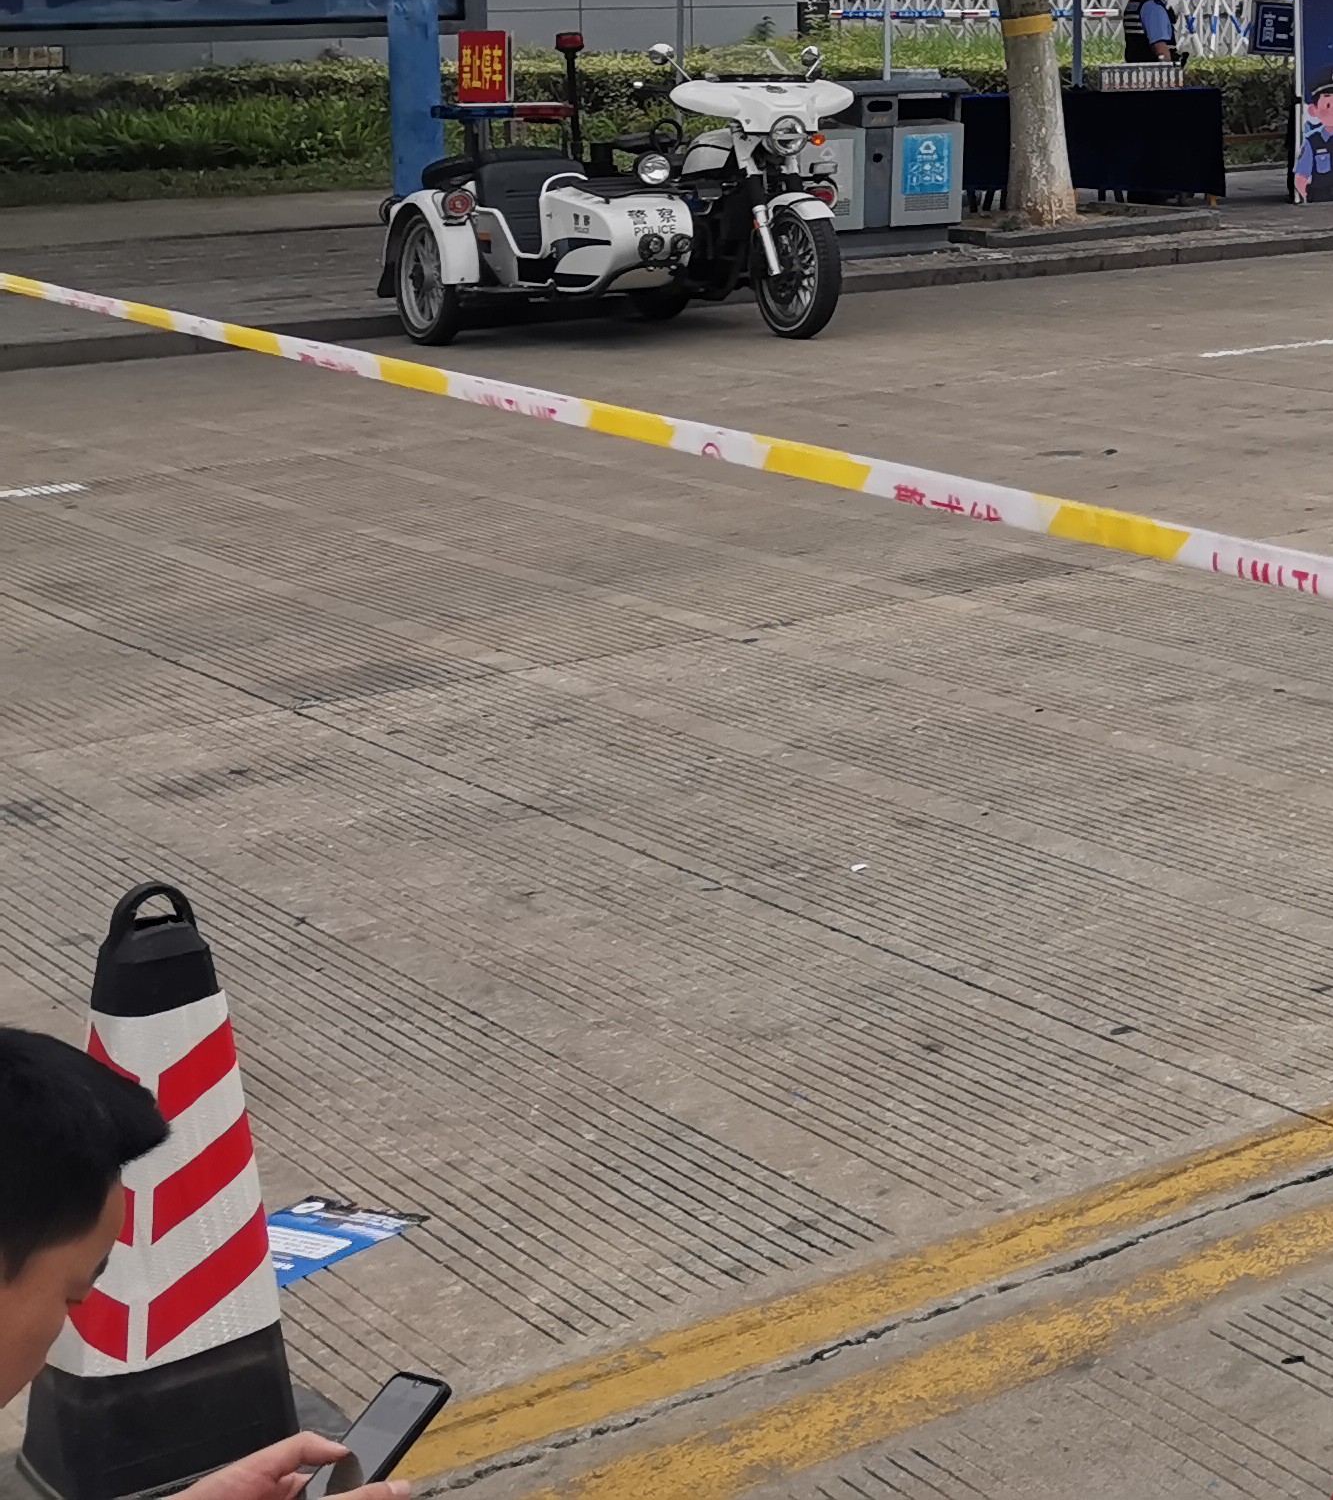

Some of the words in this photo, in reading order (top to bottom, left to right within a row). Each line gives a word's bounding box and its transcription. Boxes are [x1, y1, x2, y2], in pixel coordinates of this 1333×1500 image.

[1262, 11, 1295, 43] 高二
[461, 44, 502, 91] 禁止停车
[627, 206, 677, 227] 警察
[633, 224, 676, 236] POLICE
